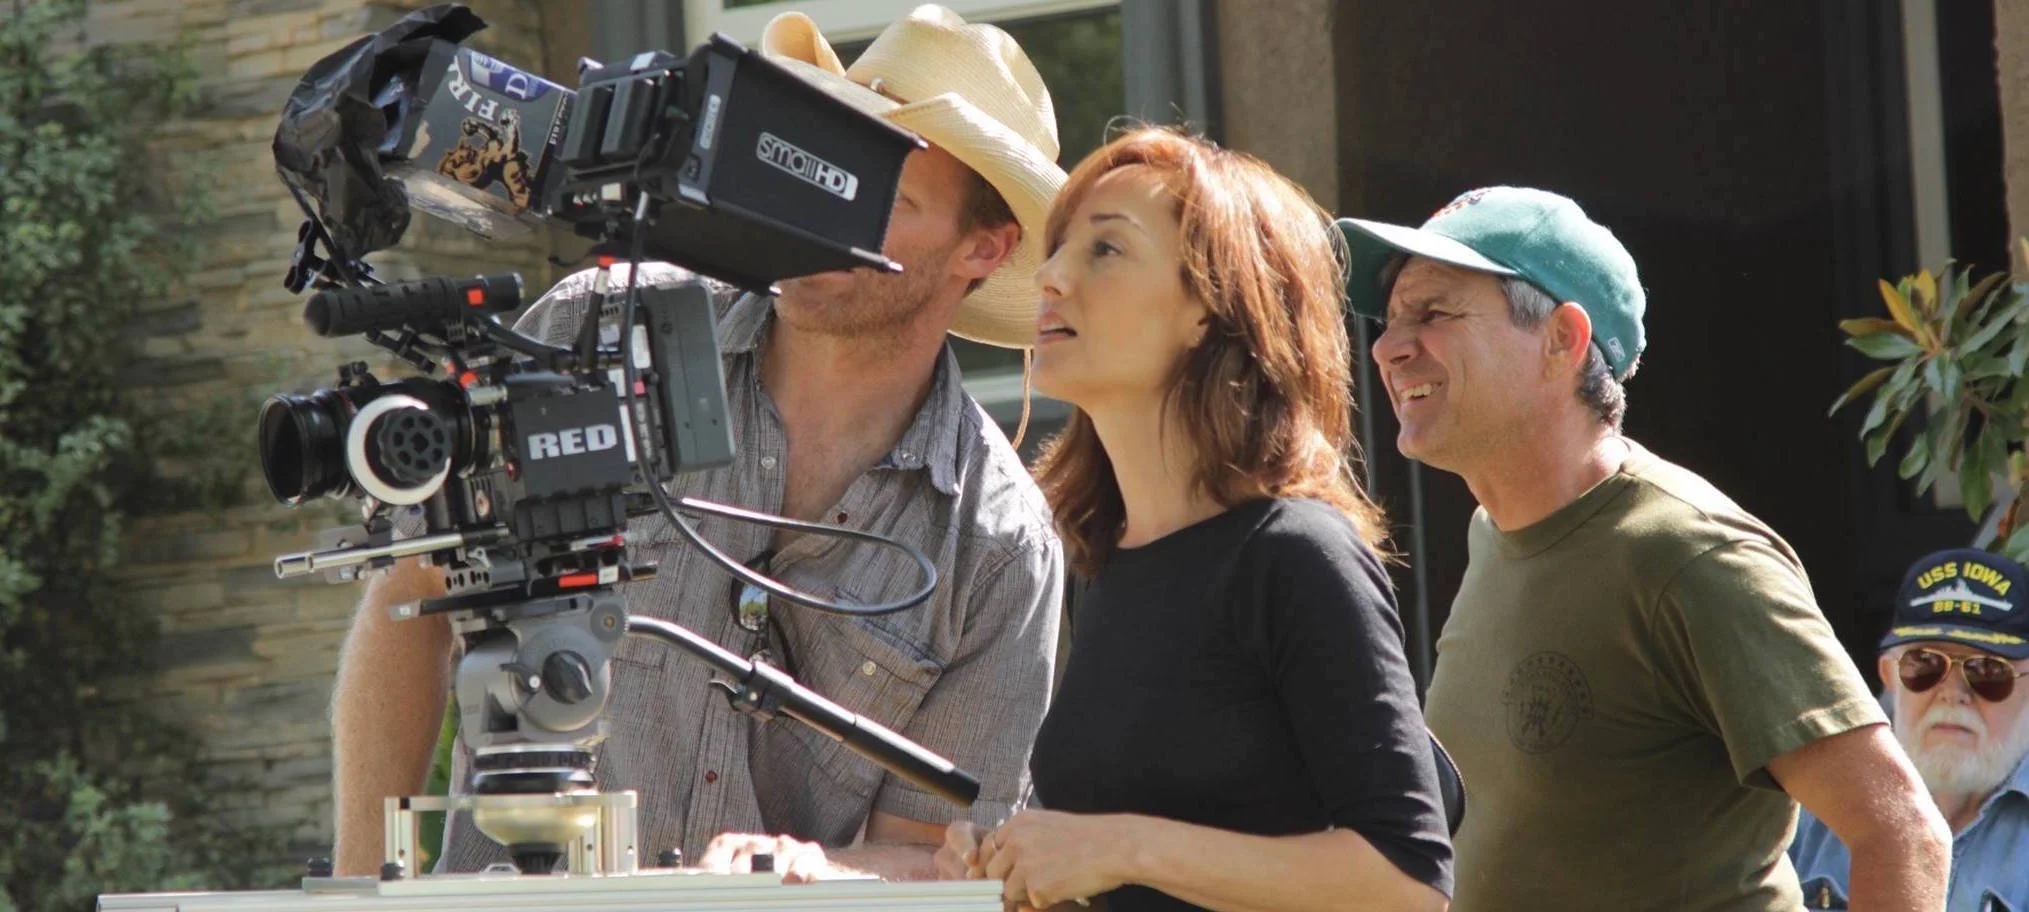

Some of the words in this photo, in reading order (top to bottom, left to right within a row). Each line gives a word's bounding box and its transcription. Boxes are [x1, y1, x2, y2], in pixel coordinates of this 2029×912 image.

[527, 423, 618, 460] RED
[1916, 560, 1958, 590] USS
[1962, 561, 2012, 597] IOWA
[1932, 600, 1982, 616] BB-61
